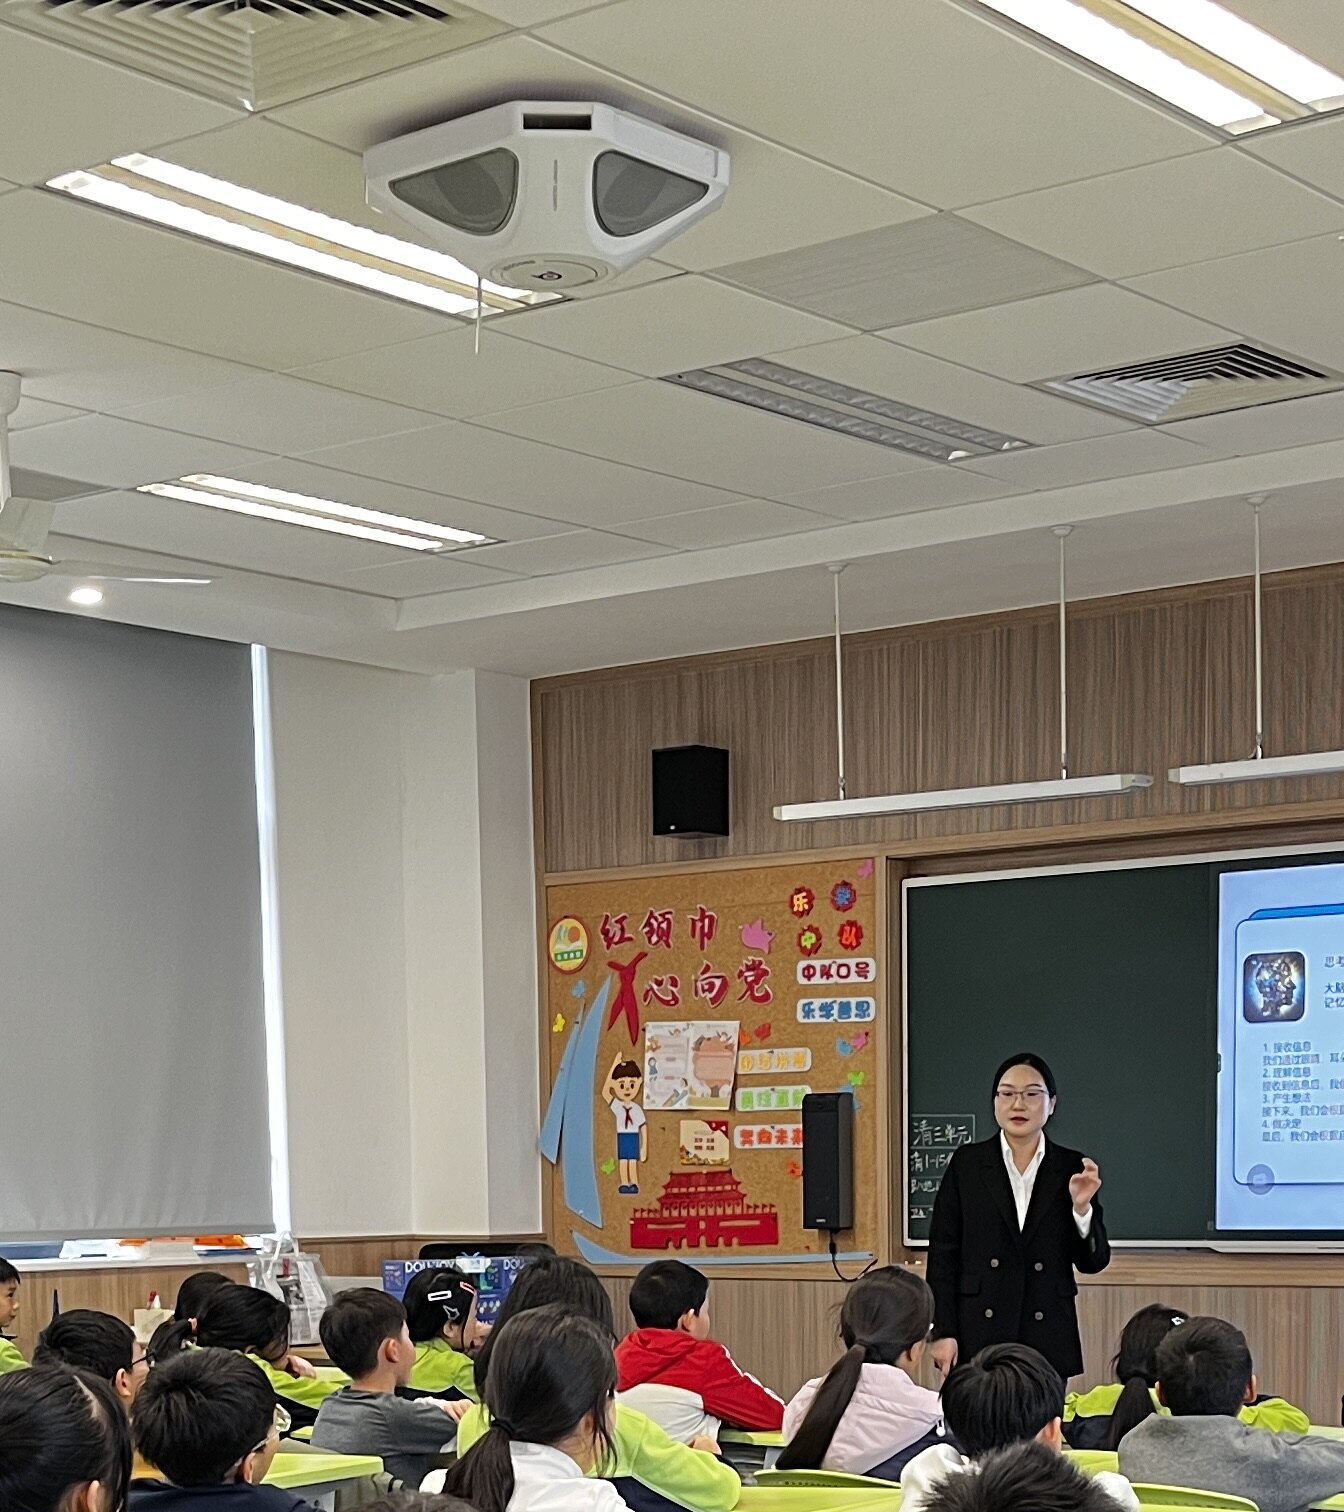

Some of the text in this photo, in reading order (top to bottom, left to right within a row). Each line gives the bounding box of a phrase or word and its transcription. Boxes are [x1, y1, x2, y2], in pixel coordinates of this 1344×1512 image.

[600, 904, 717, 951] 红领巾
[642, 956, 773, 1008] 心向党
